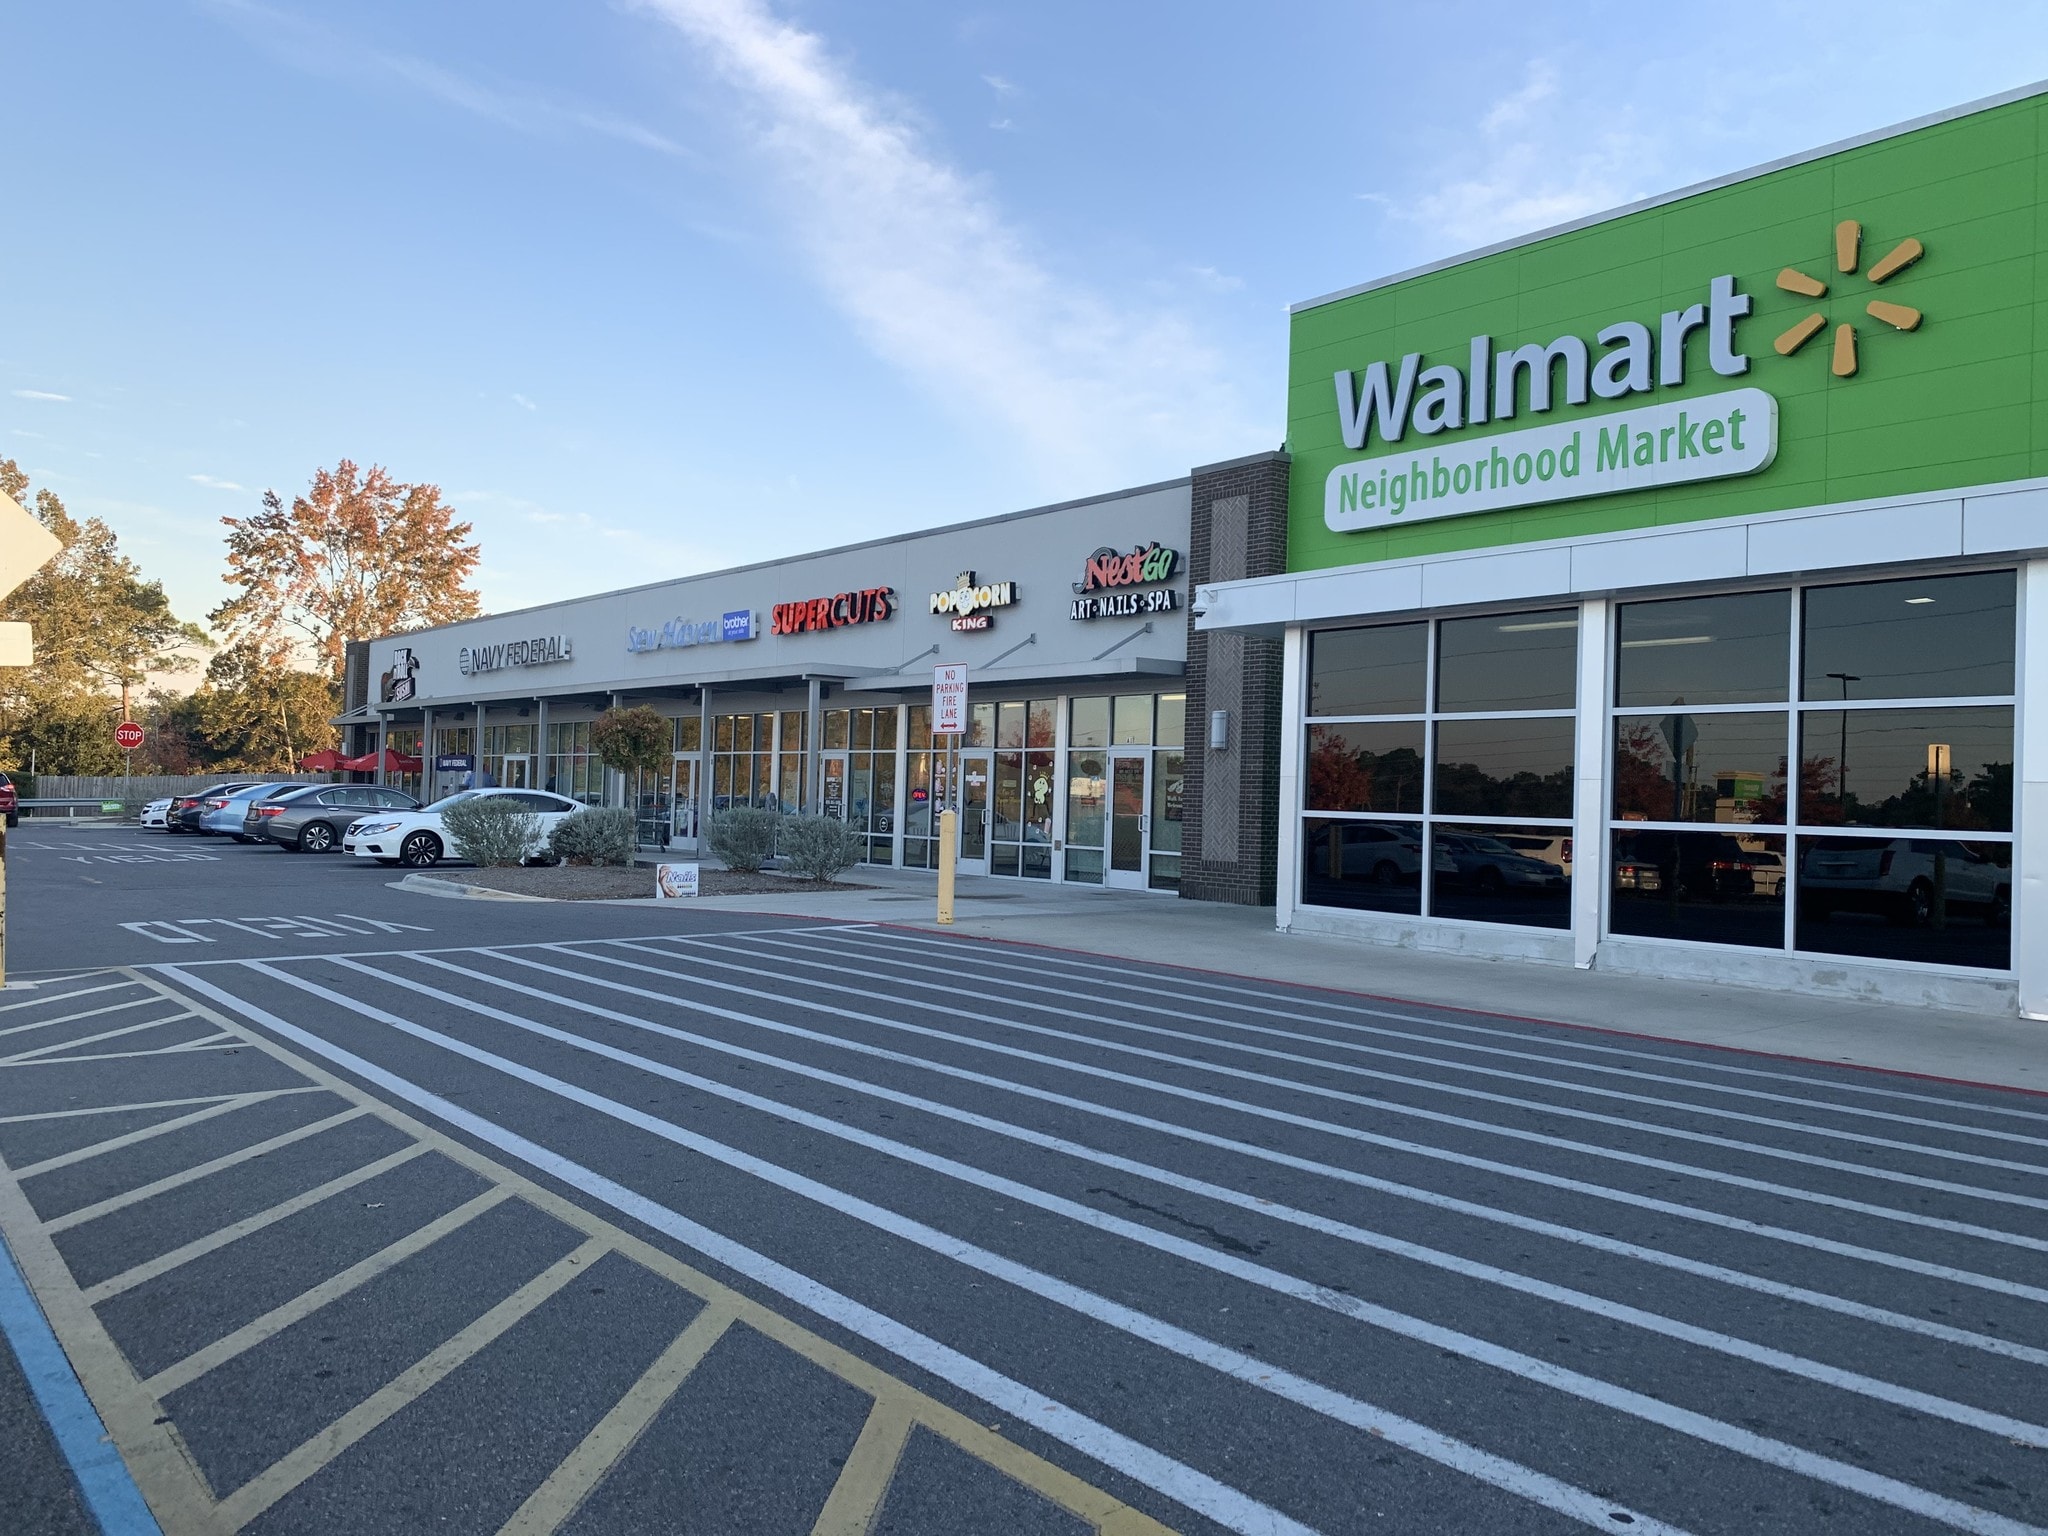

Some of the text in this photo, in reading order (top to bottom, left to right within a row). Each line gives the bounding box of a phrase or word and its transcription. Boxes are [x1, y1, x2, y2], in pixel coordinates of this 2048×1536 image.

[1333, 274, 1752, 450] Walmart
[1338, 407, 1747, 515] Neighborhood Market
[929, 582, 1011, 614] POPCORN
[1070, 589, 1171, 619] ART NAILS SPA
[771, 586, 890, 635] SUPERCUTS
[723, 616, 749, 630] brother
[951, 616, 987, 631] KING
[472, 636, 564, 671] NAVY FEDERAL
[944, 669, 956, 681] NO
[936, 682, 964, 694] PARKING
[942, 695, 957, 707] FIRE
[940, 708, 958, 719] LANE
[117, 730, 142, 740] STOP
[59, 853, 223, 865] YIELD
[665, 870, 697, 884] Nails
